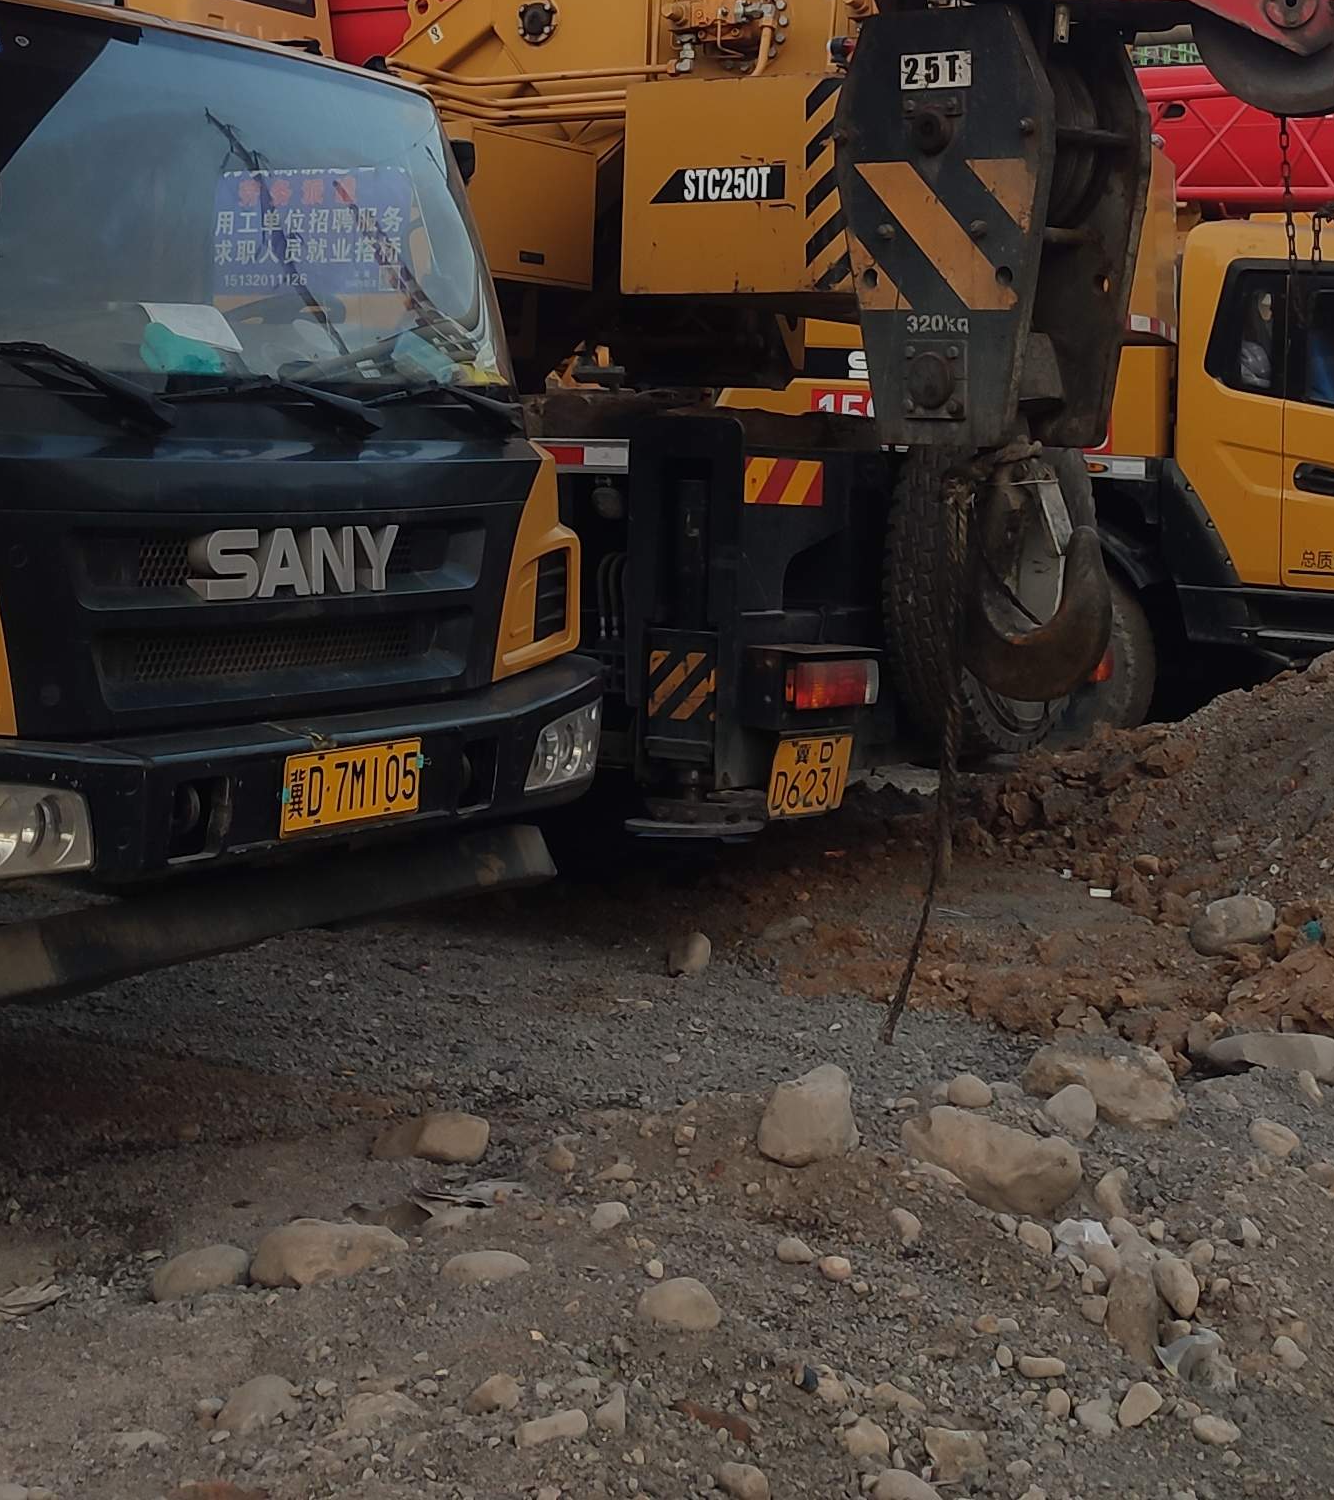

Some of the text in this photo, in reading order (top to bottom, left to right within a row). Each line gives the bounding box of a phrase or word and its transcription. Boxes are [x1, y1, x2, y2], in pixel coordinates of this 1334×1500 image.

[904, 54, 960, 85] 25T
[683, 166, 772, 200] STC250T
[215, 206, 403, 235] 用工单位招聘服务
[214, 236, 402, 266] 求职人员就业搭桥
[223, 272, 308, 288] 15132011126
[196, 524, 400, 601] SANY
